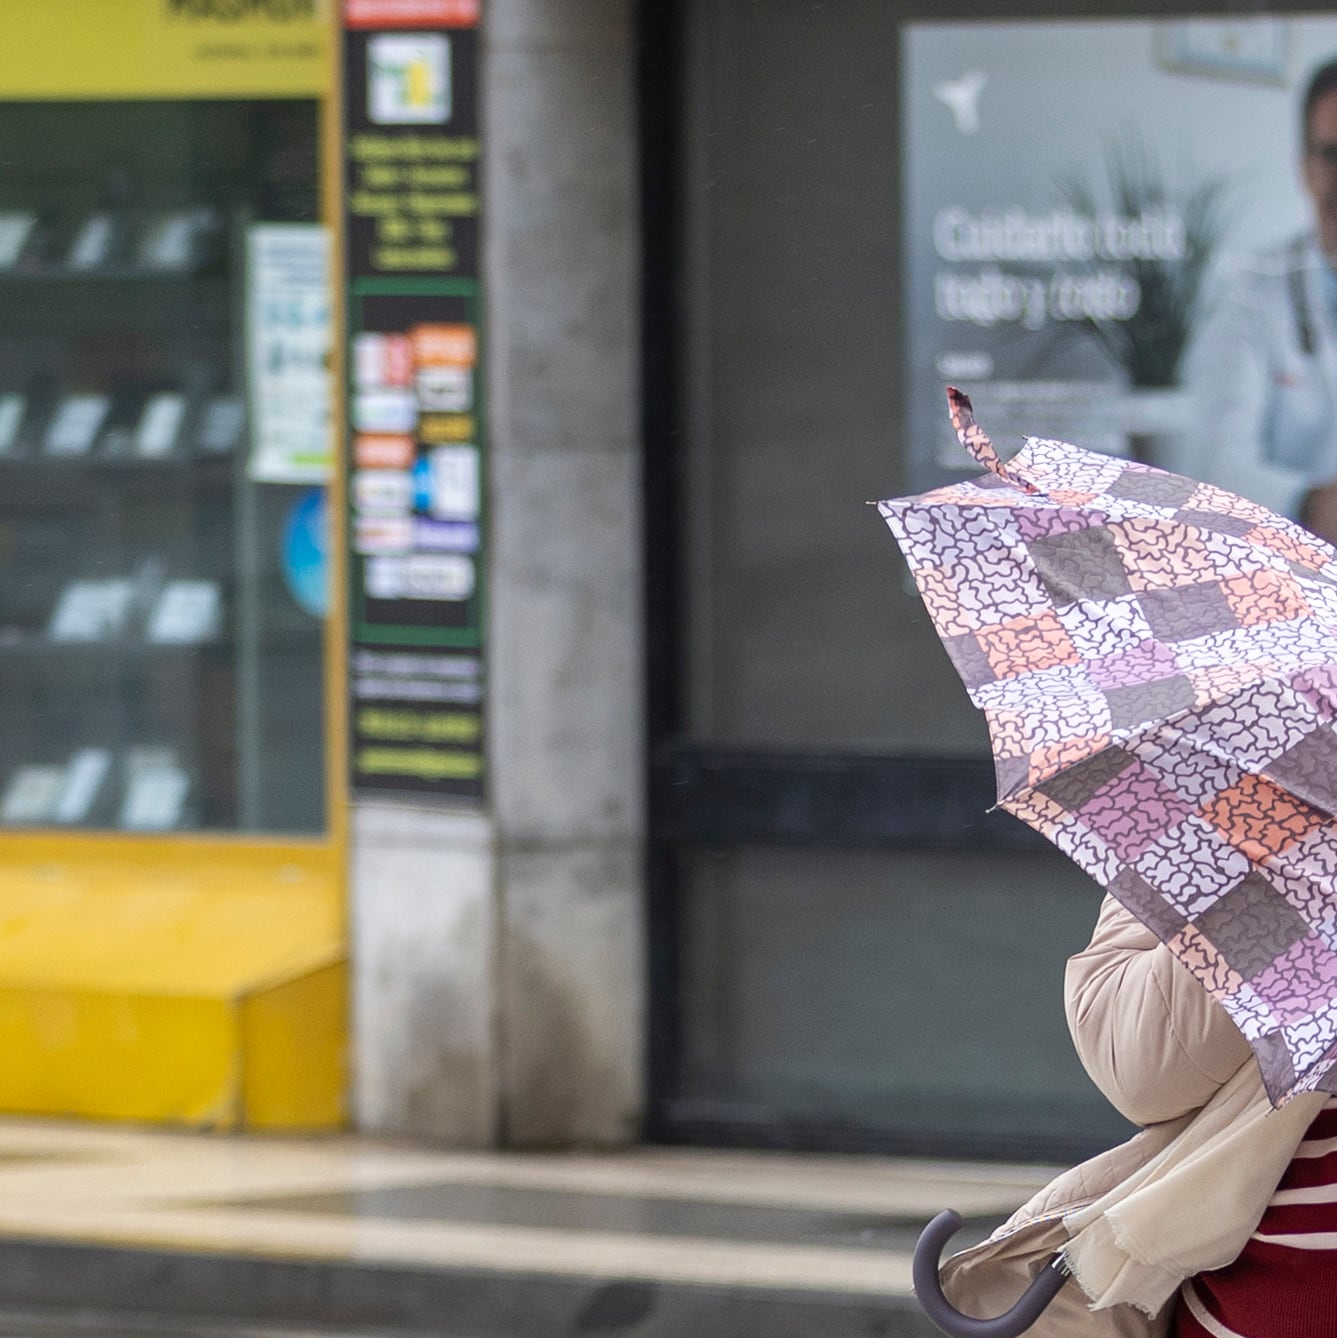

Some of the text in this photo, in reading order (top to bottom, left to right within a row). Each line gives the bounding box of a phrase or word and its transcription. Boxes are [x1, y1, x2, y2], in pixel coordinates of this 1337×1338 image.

[936, 267, 1141, 330] todo y todo
